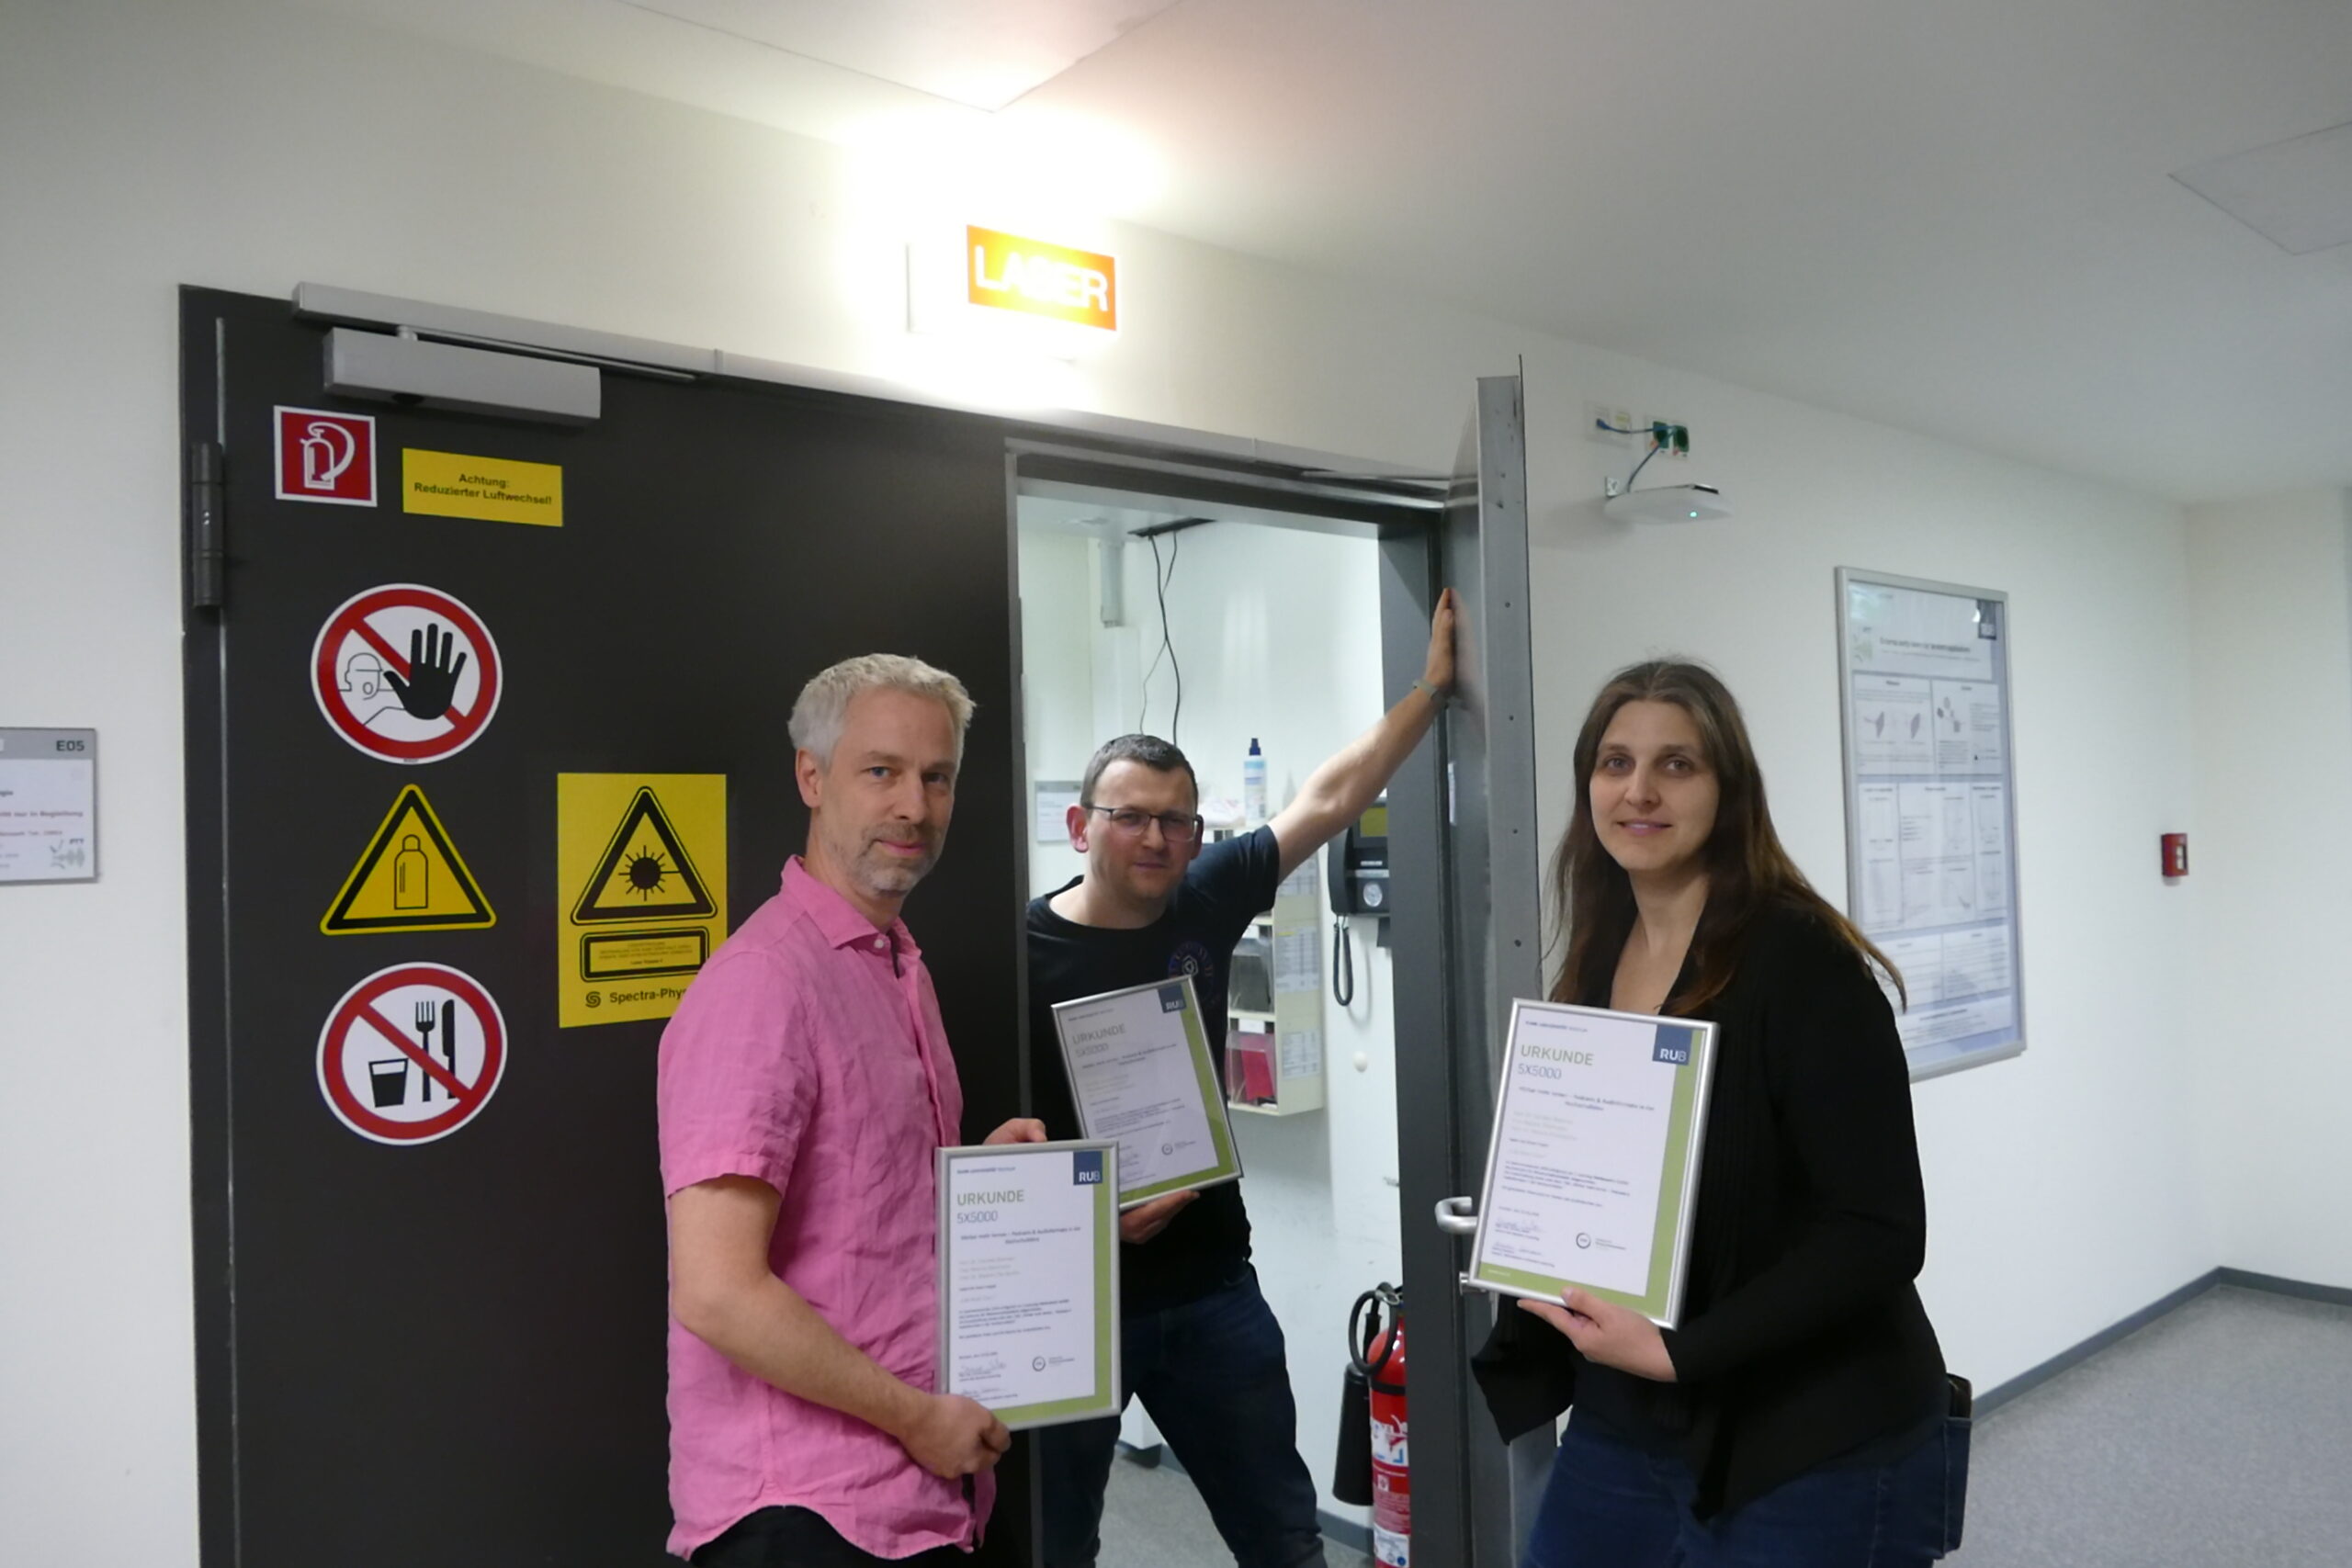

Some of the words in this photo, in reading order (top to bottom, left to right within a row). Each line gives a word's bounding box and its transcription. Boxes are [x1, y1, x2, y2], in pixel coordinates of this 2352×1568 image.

[458, 473, 510, 489] Achtung:
[413, 482, 481, 498] Reduzierter
[56, 740, 85, 751] E05
[1072, 1023, 1126, 1045] URKUNDE
[1521, 1044, 1594, 1066] URKUNDE
[1659, 1047, 1687, 1063] RUB
[1518, 1064, 1562, 1079] 5X5000
[1079, 1170, 1101, 1183] RUB
[956, 1190, 1025, 1206] URKUNDE
[956, 1211, 999, 1224] 5X5000
